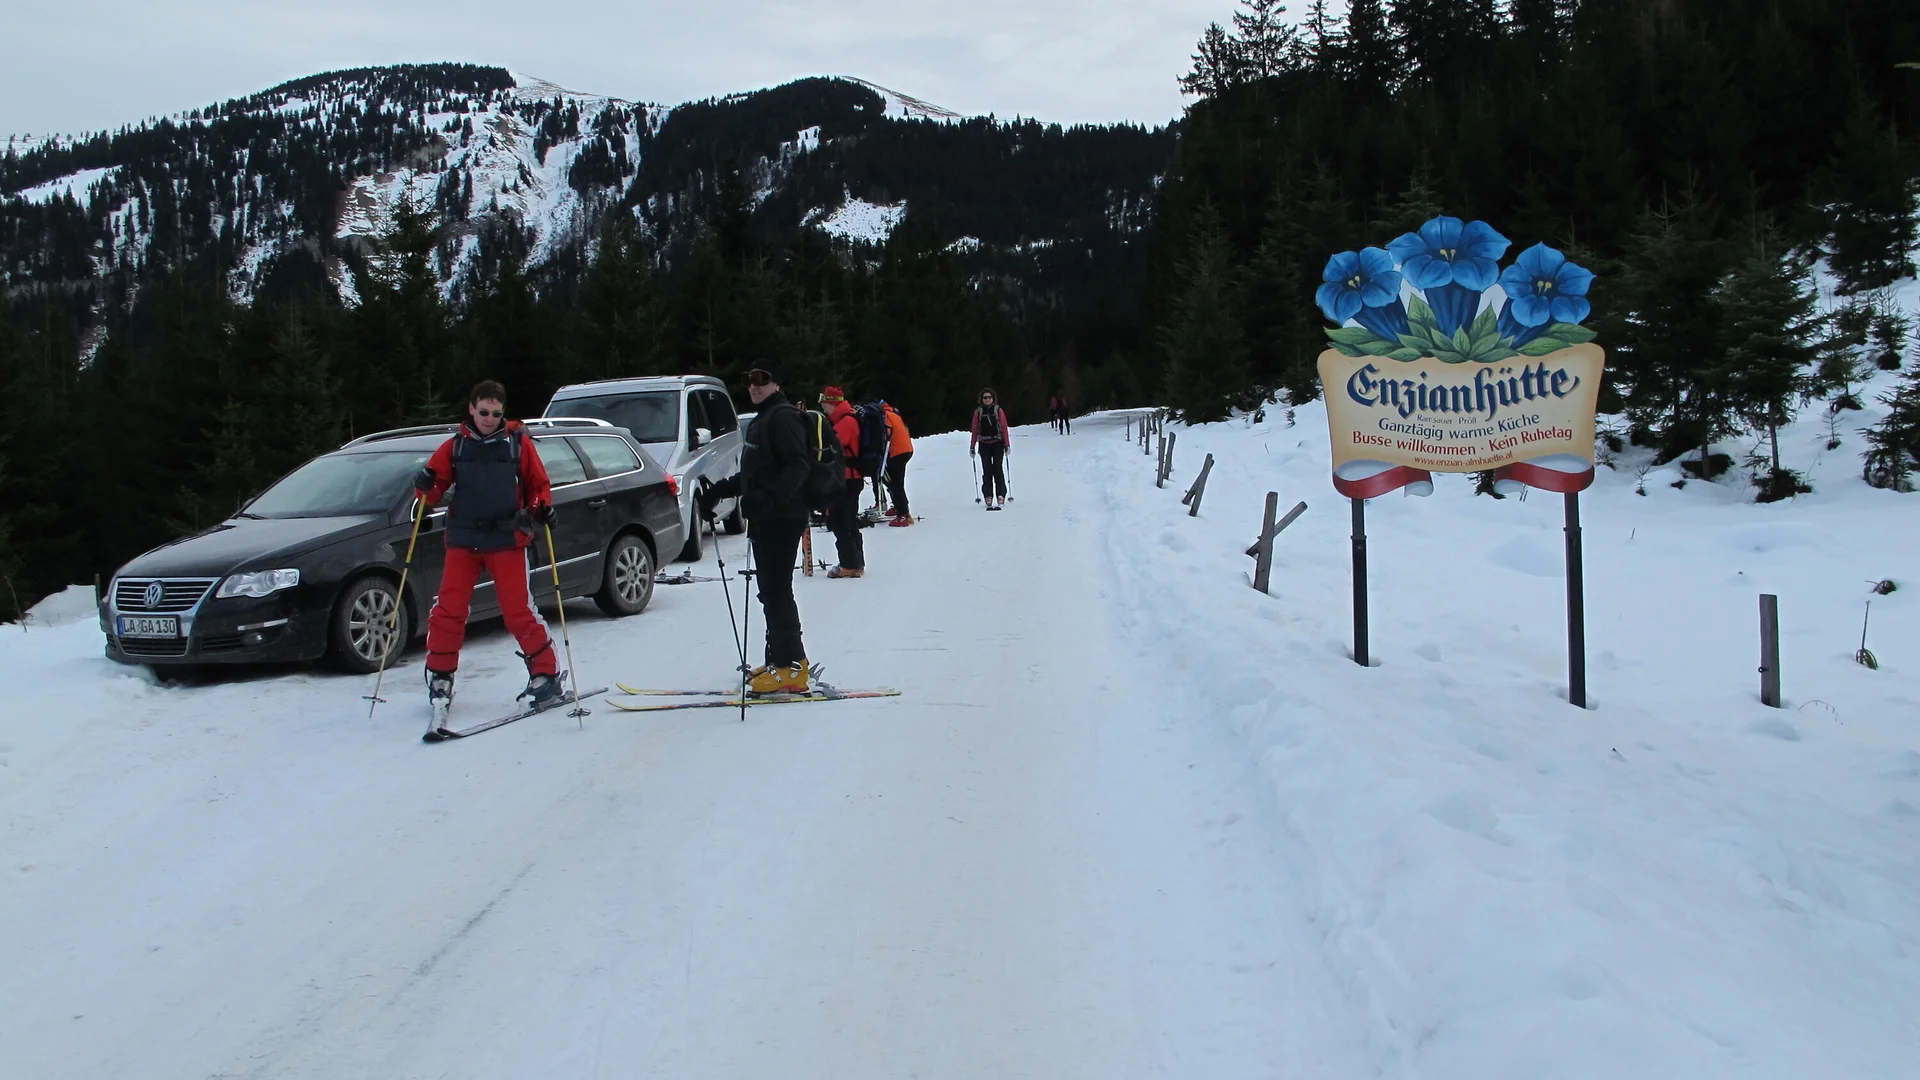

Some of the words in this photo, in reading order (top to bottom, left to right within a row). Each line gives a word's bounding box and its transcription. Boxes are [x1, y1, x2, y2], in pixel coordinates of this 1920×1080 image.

[1347, 361, 1580, 421] Enzianhütte
[1378, 417, 1443, 441] Ganztägig
[1449, 425, 1494, 439] warme
[1497, 413, 1540, 432] Küche
[1458, 415, 1477, 424] Pröll
[1352, 430, 1392, 447] Busse
[1397, 440, 1476, 456] willkommen
[1488, 436, 1518, 452] Kein
[1521, 426, 1572, 443] Ruhetag
[1414, 451, 1513, 467] www.enzian-almhuette.at
[123, 619, 136, 633] LA
[141, 620, 154, 633] GA
[156, 620, 175, 633] 130
